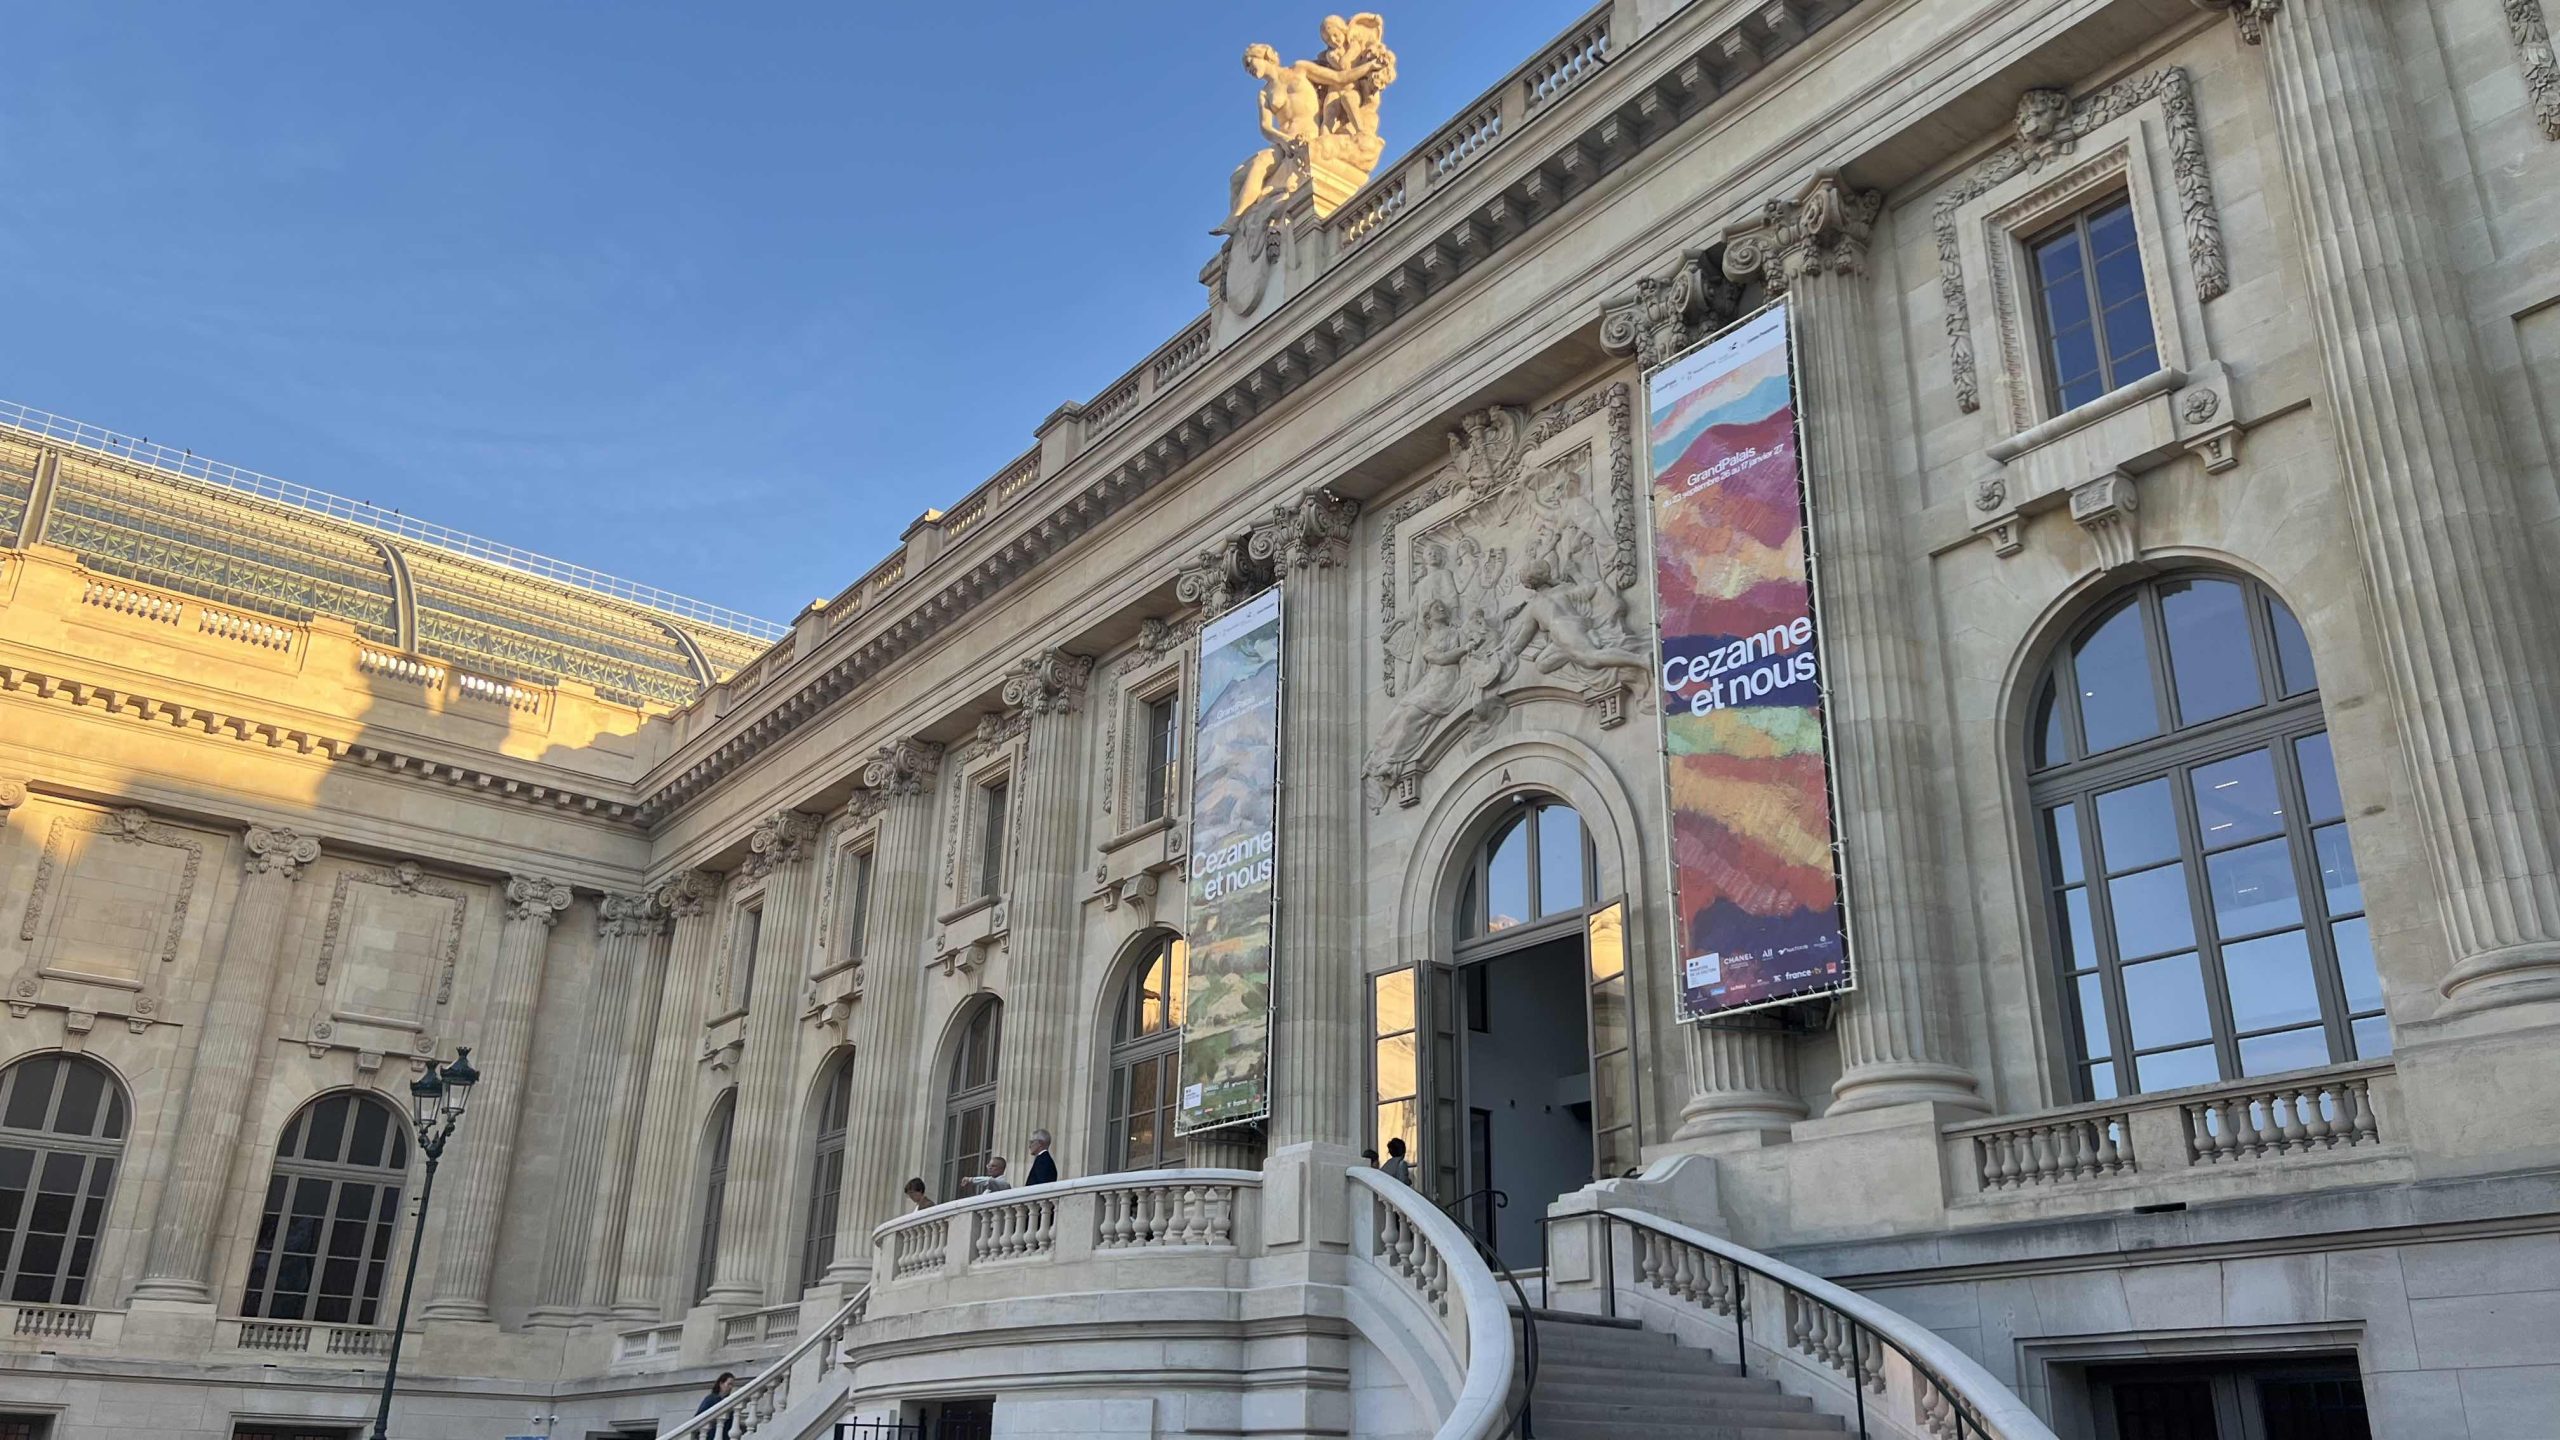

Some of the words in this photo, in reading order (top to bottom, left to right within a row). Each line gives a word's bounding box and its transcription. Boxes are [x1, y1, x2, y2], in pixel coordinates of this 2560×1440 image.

[1682, 476, 1720, 499] septembre
[1731, 466, 1741, 476] au
[1748, 450, 1773, 469] janvier
[1687, 447, 1756, 486] GrandPalais
[1663, 616, 1812, 692] Cezanne
[1691, 677, 1725, 717] et
[1729, 651, 1816, 705] nous
[1501, 768, 1511, 785] A
[1192, 830, 1273, 879] Cezanne
[1205, 871, 1223, 900] et
[1226, 858, 1272, 894] nous
[1723, 953, 1754, 965] CHANEL
